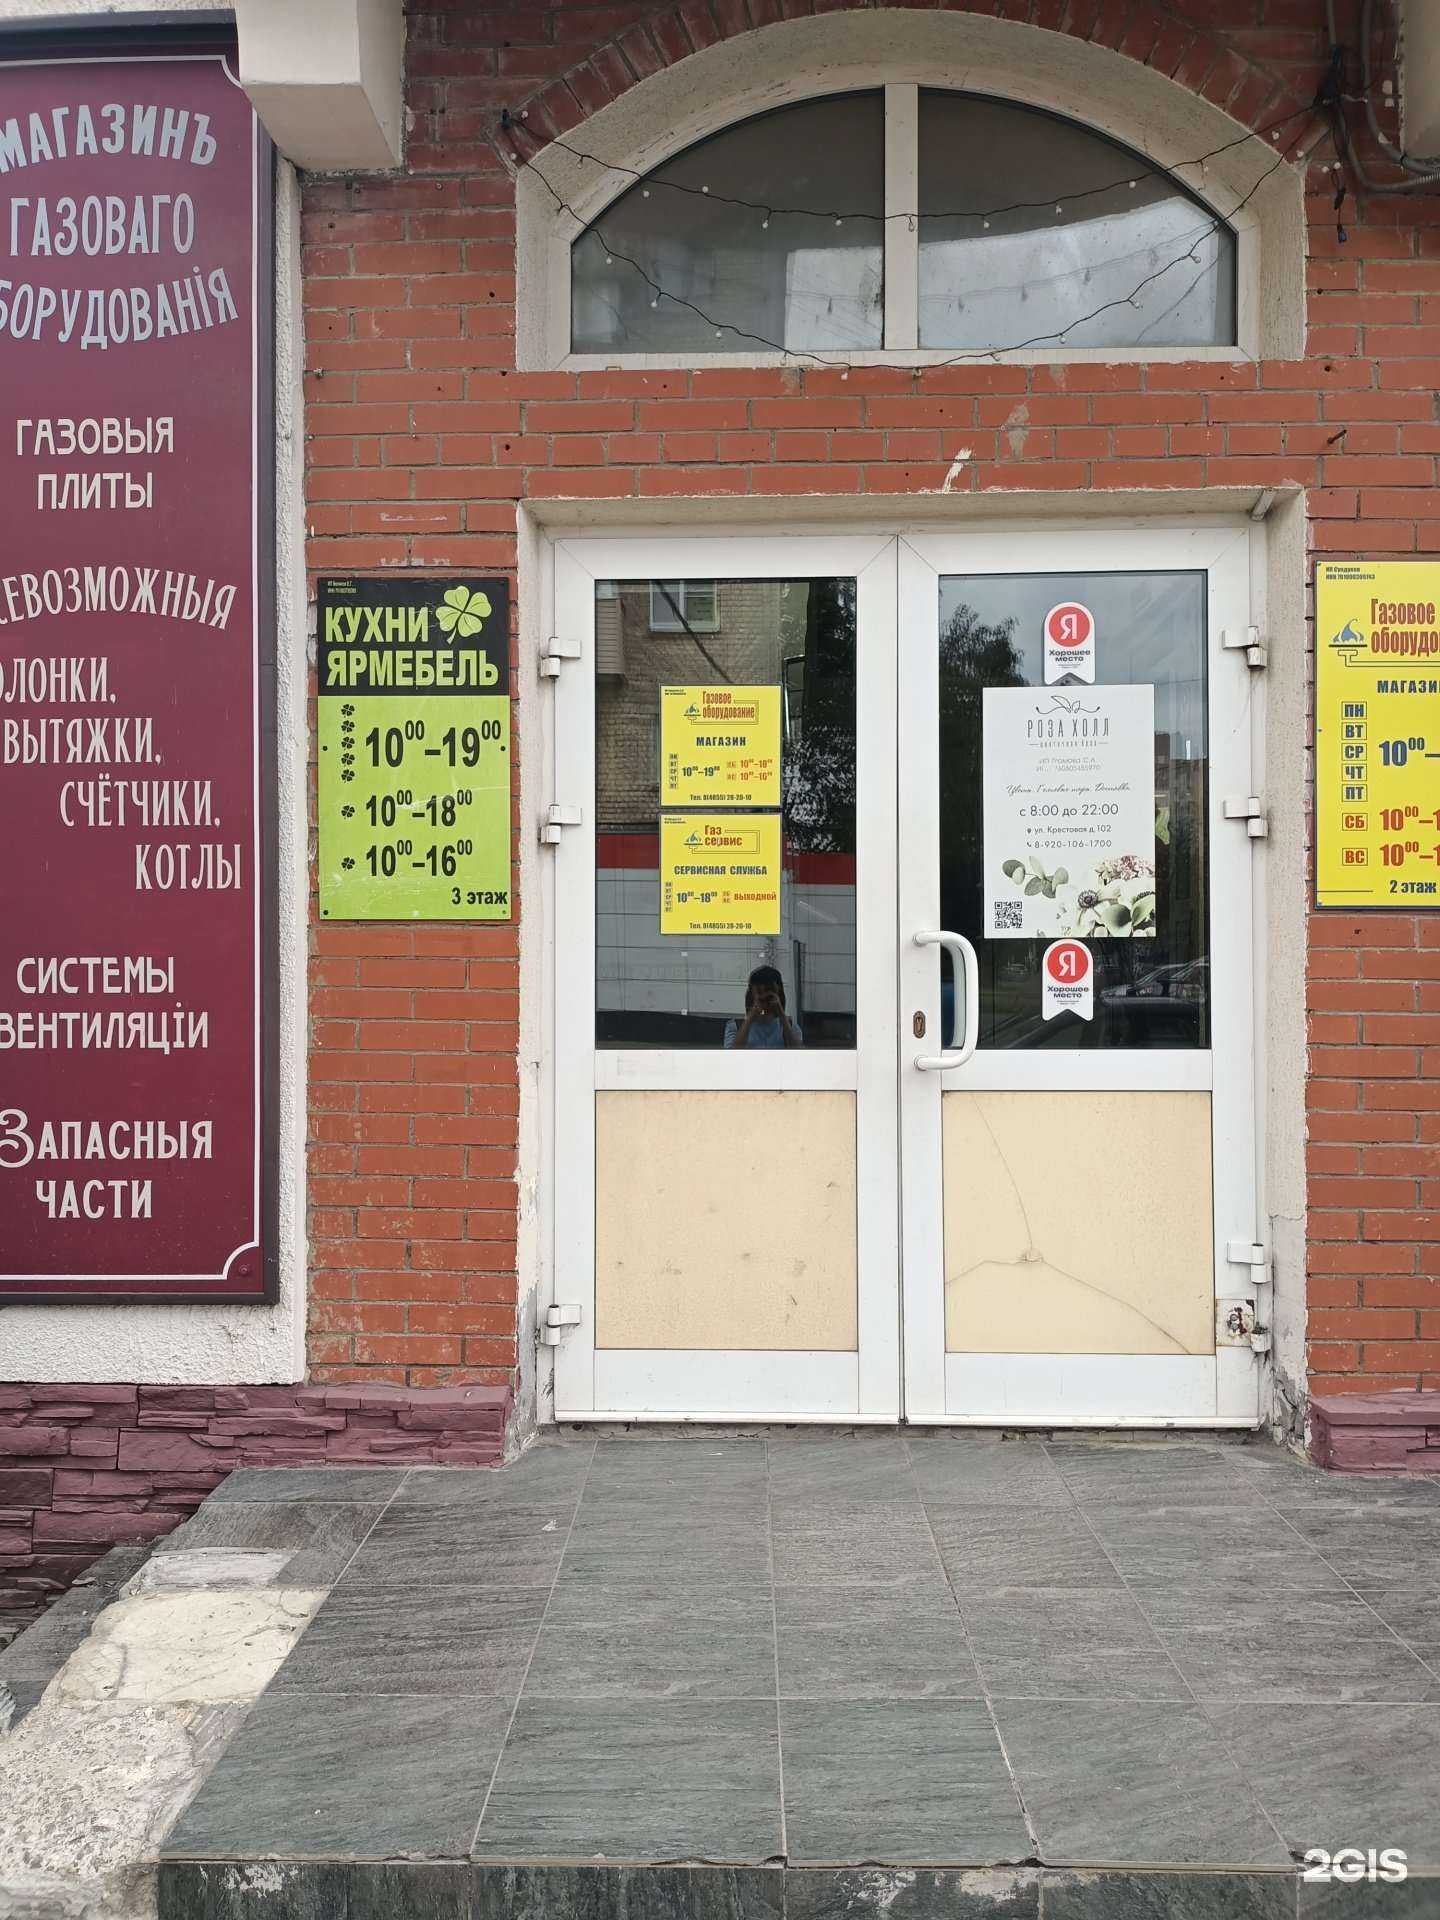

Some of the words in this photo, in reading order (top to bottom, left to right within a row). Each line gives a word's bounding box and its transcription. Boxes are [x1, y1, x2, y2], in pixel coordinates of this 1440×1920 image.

[0, 103, 217, 173] МАГАЗИНЪ
[10, 193, 195, 256] ГАЗОВАГО
[16, 416, 174, 455] ГАЗОВЫЯ
[37, 472, 153, 509] ПЛИТЫ
[0, 566, 237, 630] ЕВОЗМОЖНЫЯ
[1371, 598, 1436, 625] Газовое
[325, 607, 429, 642] КУХНИ
[1060, 613, 1078, 640] Я
[1371, 627, 1440, 657] оборудо
[1049, 649, 1091, 657] Хорошее
[326, 650, 499, 686] ЯРМЕБЕЛЬ
[0, 657, 116, 703] ЛОНКИ,
[1377, 680, 1440, 694] МАГАЗИ
[702, 691, 732, 705] Газовое
[702, 705, 755, 721] оборудование
[1344, 704, 1364, 718] ПН
[1027, 719, 1064, 738] РОЗА
[1072, 718, 1109, 737] ХОЛЛ
[1345, 724, 1364, 738] ВТ
[696, 736, 747, 747] МАГАЗИН
[1344, 745, 1364, 759] СР
[1345, 766, 1364, 780] ЧТ
[1345, 786, 1364, 800] ПТ
[1019, 807, 1027, 817] с
[1030, 804, 1059, 817] 8:00
[1061, 808, 1078, 817] до
[1081, 803, 1119, 816] 22:00
[1344, 815, 1365, 829] СБ
[704, 824, 722, 836] Газ
[1047, 825, 1088, 836] Крестовая
[1034, 839, 1112, 849] 8-920-106-1700
[1345, 850, 1365, 864] ВС
[135, 844, 241, 889] КОТЛЫ
[674, 865, 726, 875] СЕРВИСНАЯ
[730, 865, 768, 875] СЛУЖБА
[1389, 880, 1398, 894] 2
[1401, 882, 1437, 894] этаж
[451, 887, 461, 905] 3
[466, 891, 508, 905] этаж
[1058, 950, 1076, 977] Я
[16, 957, 174, 993] СИСТЕМЫ
[1047, 985, 1089, 993] Хорошее
[36, 1180, 152, 1219] ЧАСТИ
